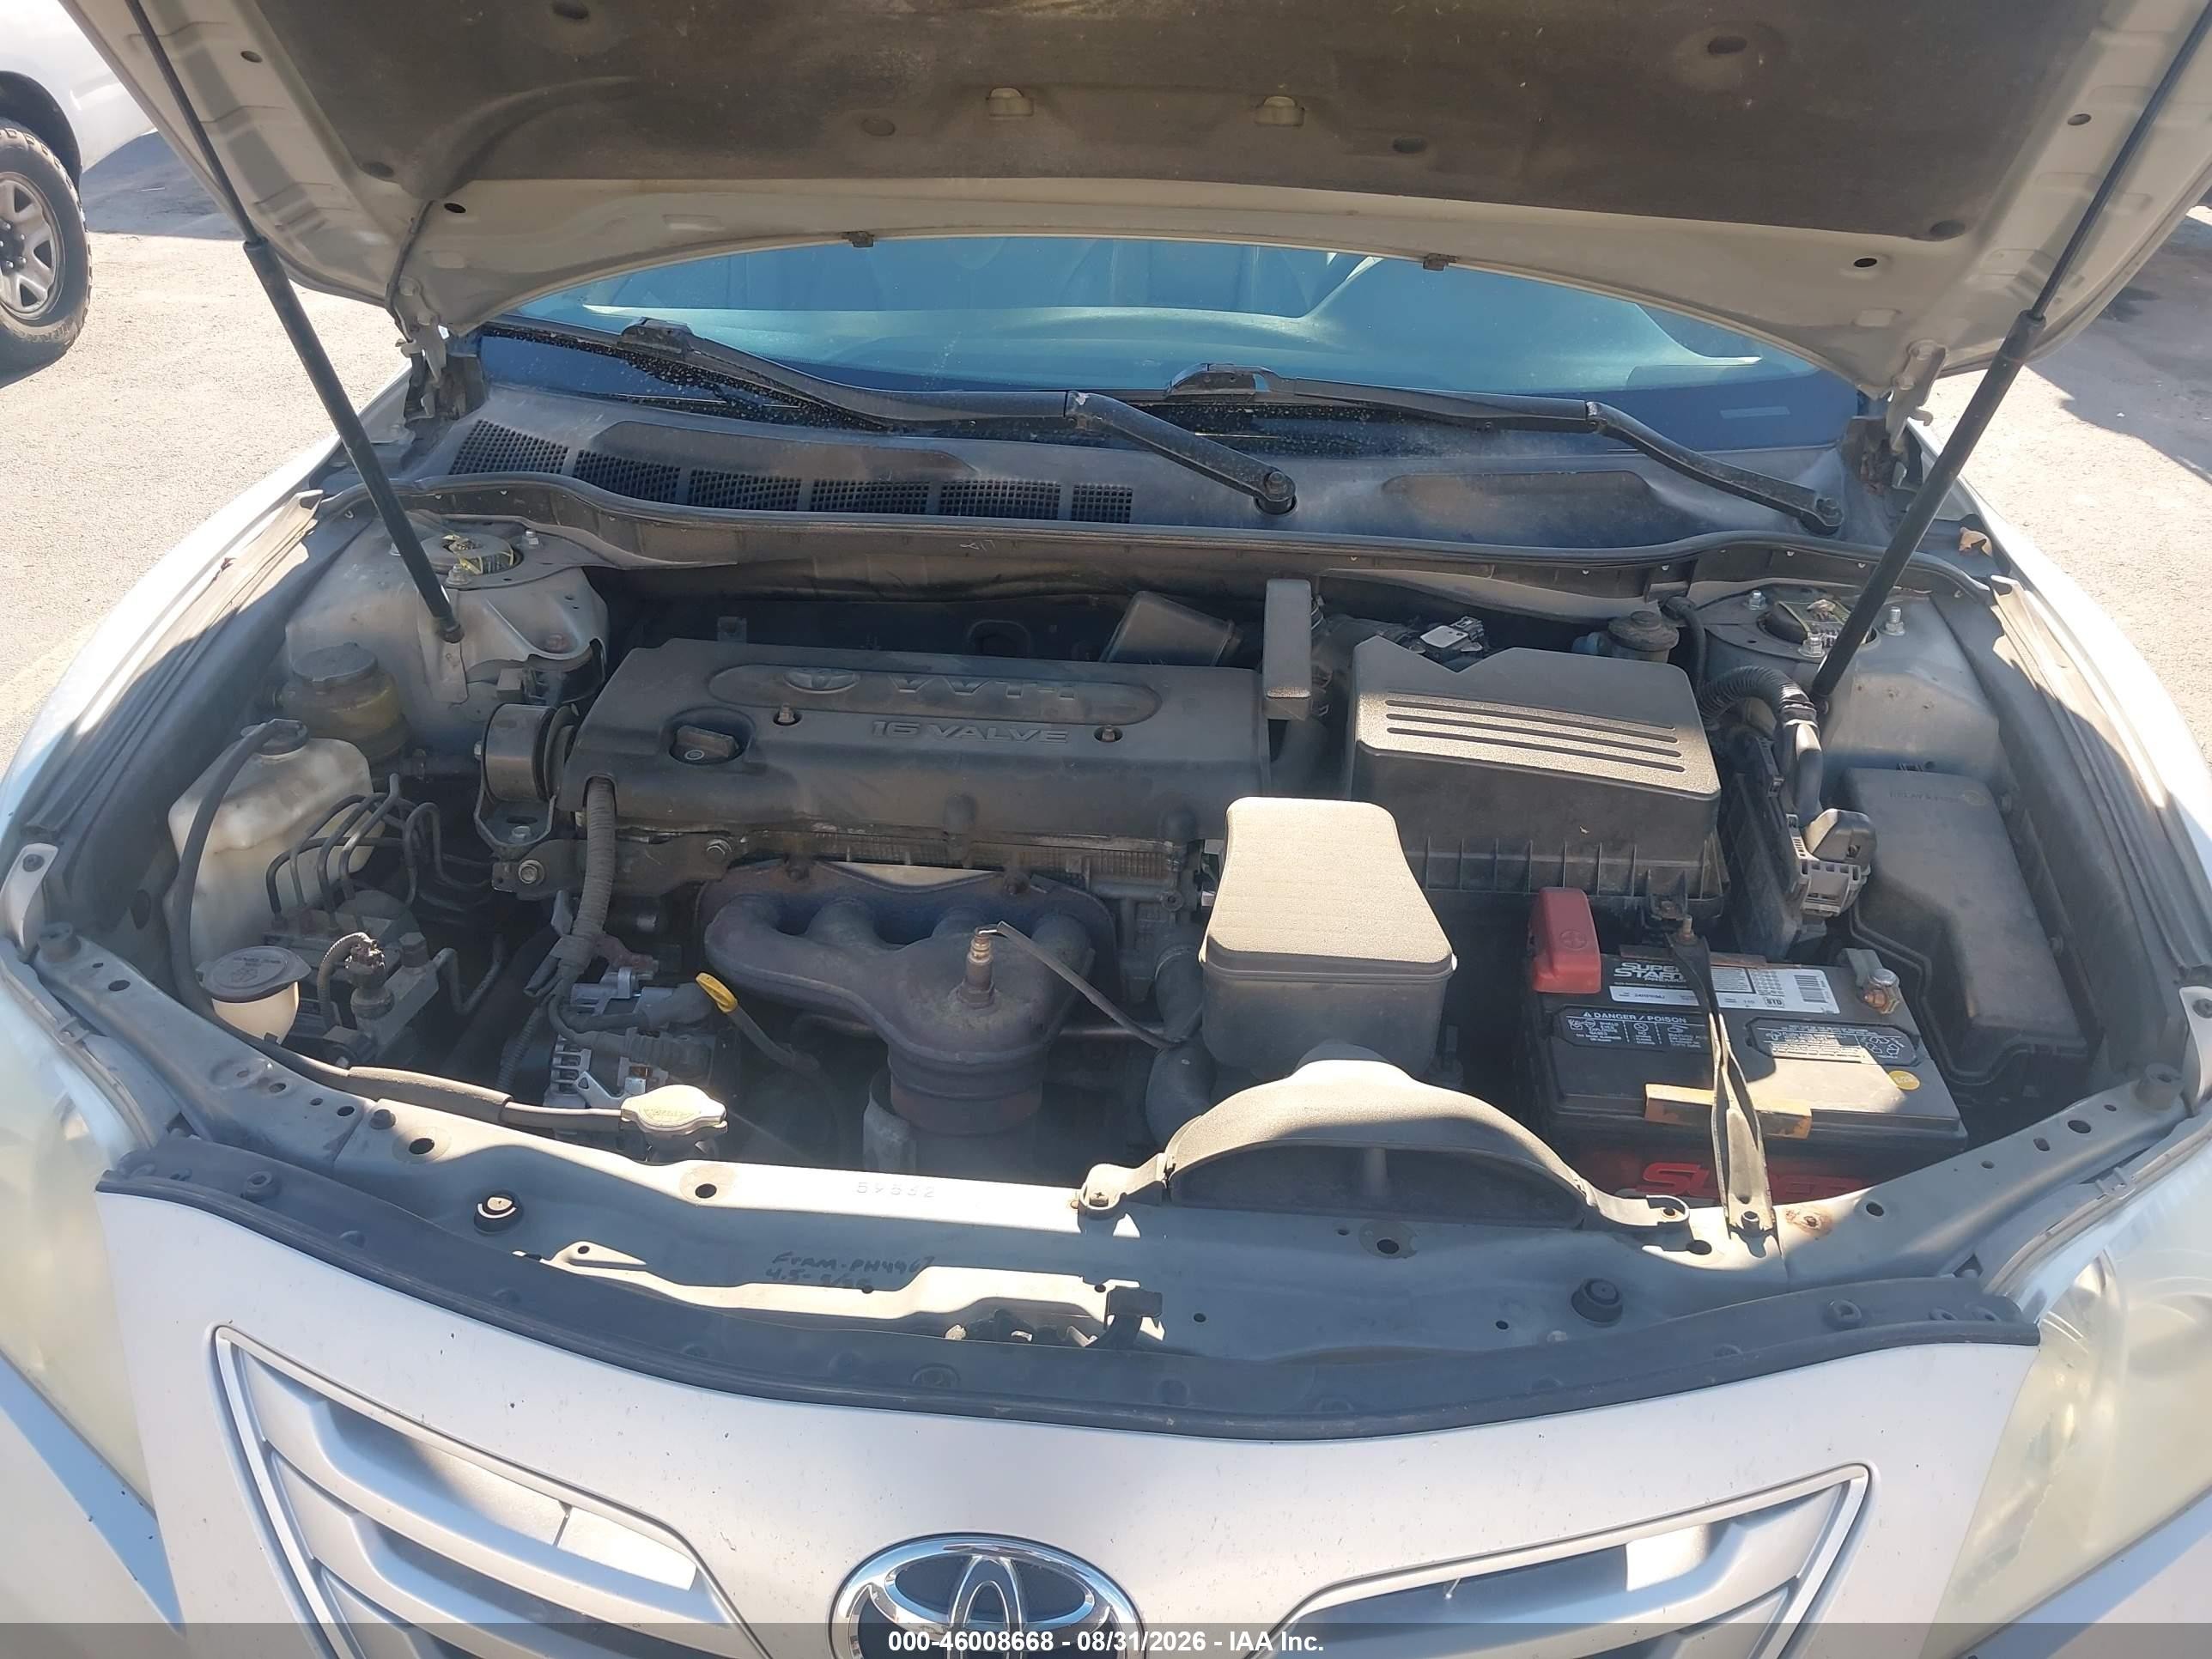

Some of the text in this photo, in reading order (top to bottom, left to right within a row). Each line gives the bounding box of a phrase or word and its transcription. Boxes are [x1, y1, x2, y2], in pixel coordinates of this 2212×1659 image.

[872, 720, 1070, 744] 16 VALVE
[1621, 962, 1680, 973] SUPE
